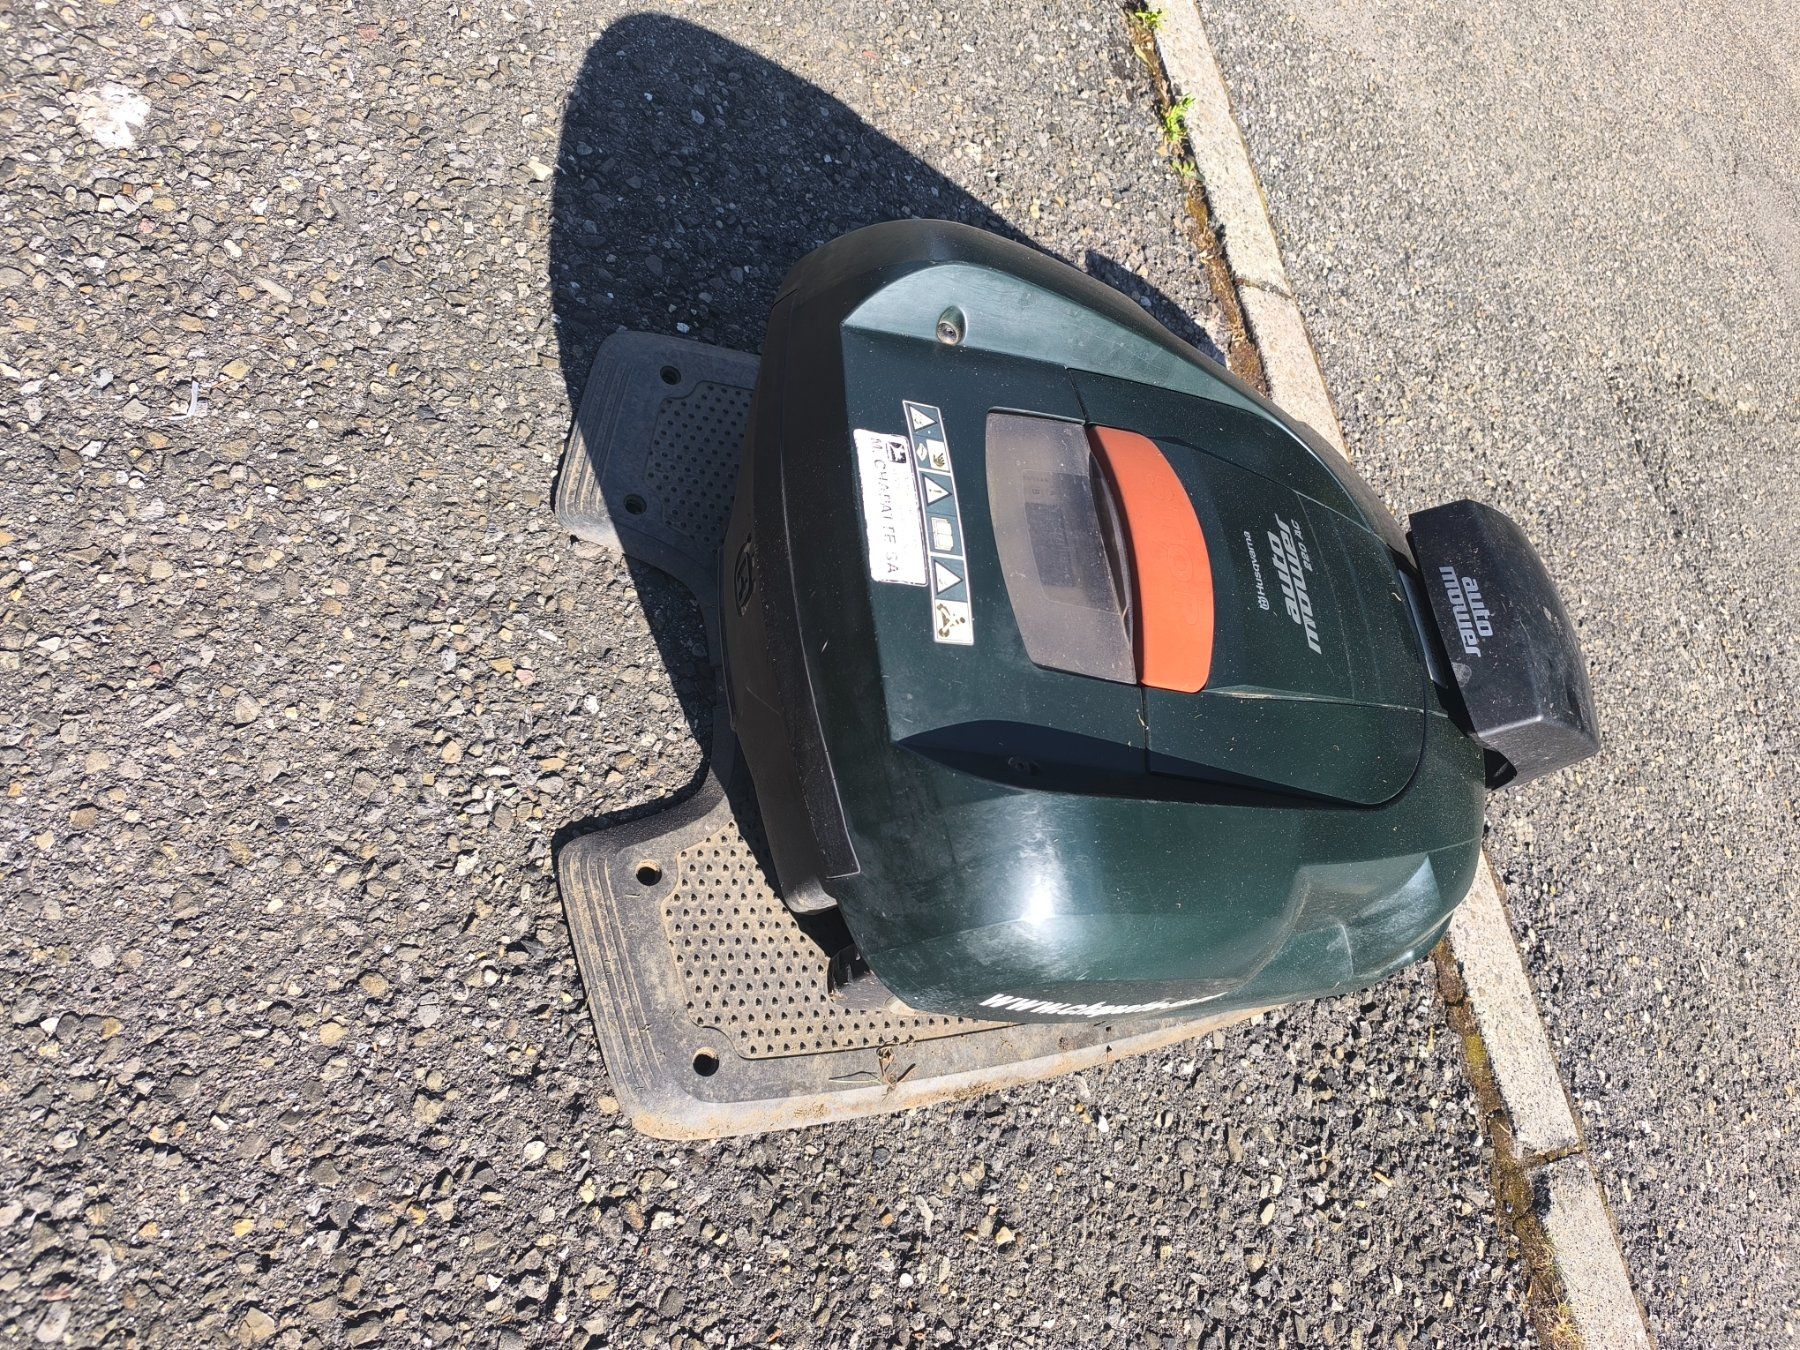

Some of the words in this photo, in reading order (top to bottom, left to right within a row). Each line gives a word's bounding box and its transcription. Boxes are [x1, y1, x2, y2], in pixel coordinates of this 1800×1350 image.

[1290, 518, 1304, 541] AC
[1297, 543, 1314, 572] 220
[1243, 531, 1266, 596] Husqvarna
[1266, 531, 1302, 625] auto
[1274, 513, 1323, 655] mower
[1438, 565, 1482, 658] mower
[1462, 576, 1494, 637] auto
